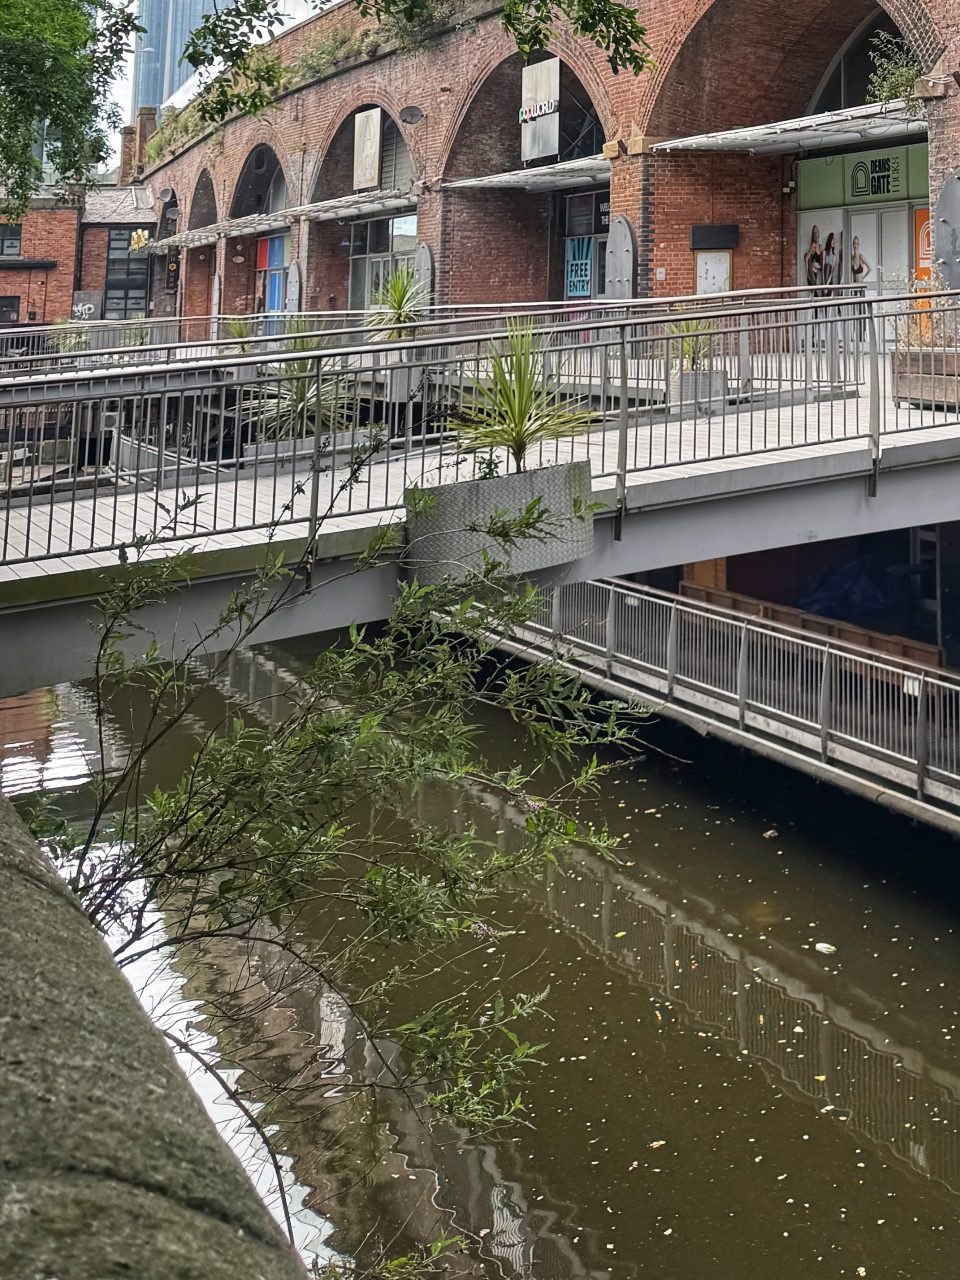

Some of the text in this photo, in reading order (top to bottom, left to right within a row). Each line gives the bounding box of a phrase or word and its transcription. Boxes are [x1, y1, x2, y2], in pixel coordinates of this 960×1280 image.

[870, 157, 891, 175] DEANS
[870, 174, 891, 196] GATE
[570, 262, 588, 279] FREE
[569, 280, 590, 293] ENTRY
